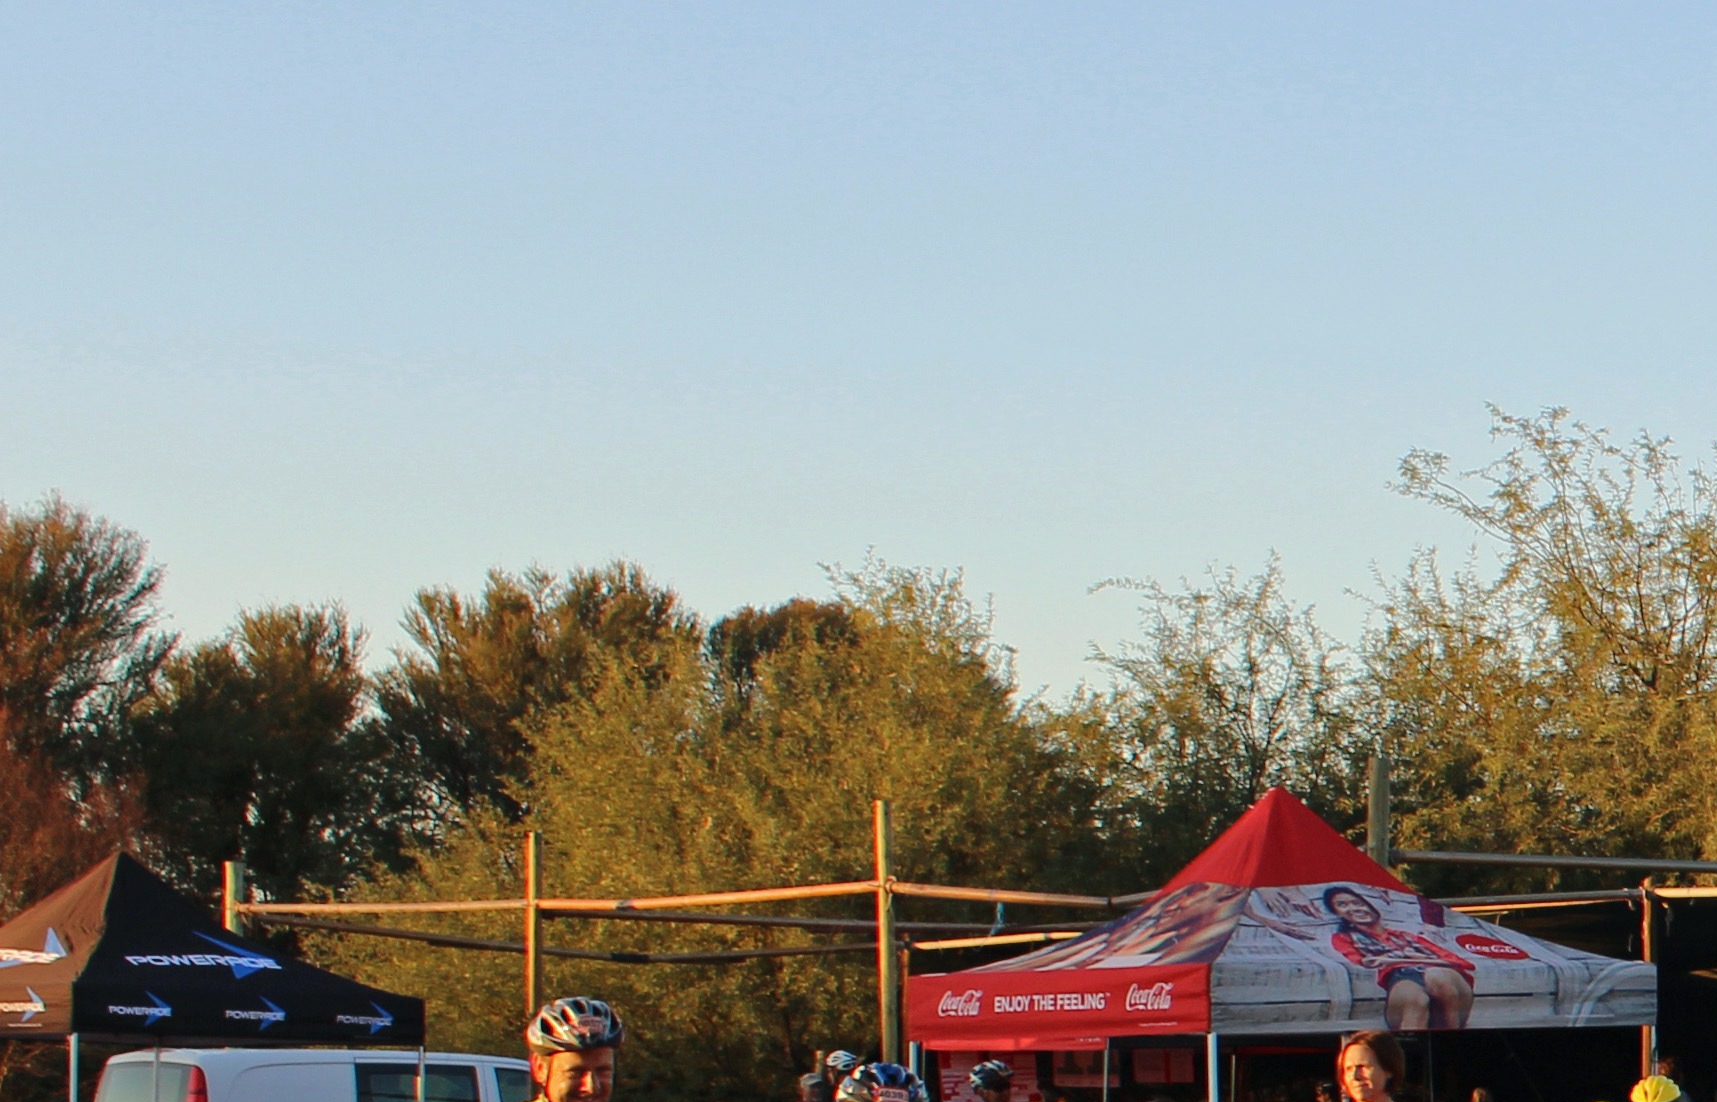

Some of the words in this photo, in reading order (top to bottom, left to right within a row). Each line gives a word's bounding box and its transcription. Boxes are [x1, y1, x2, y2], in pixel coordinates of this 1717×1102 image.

[1464, 941, 1521, 956] Coca-Cola
[125, 953, 282, 971] POWERADE
[937, 989, 984, 1017] Coca-Cola
[994, 995, 1032, 1012] ENJOY
[1033, 994, 1055, 1011] THE
[1125, 982, 1174, 1011] Coca-Cola
[0, 1002, 45, 1012] OWERADE
[109, 1005, 172, 1017] POWERADE
[225, 1010, 285, 1022] POWERADE
[337, 1015, 392, 1026] POWERADE
